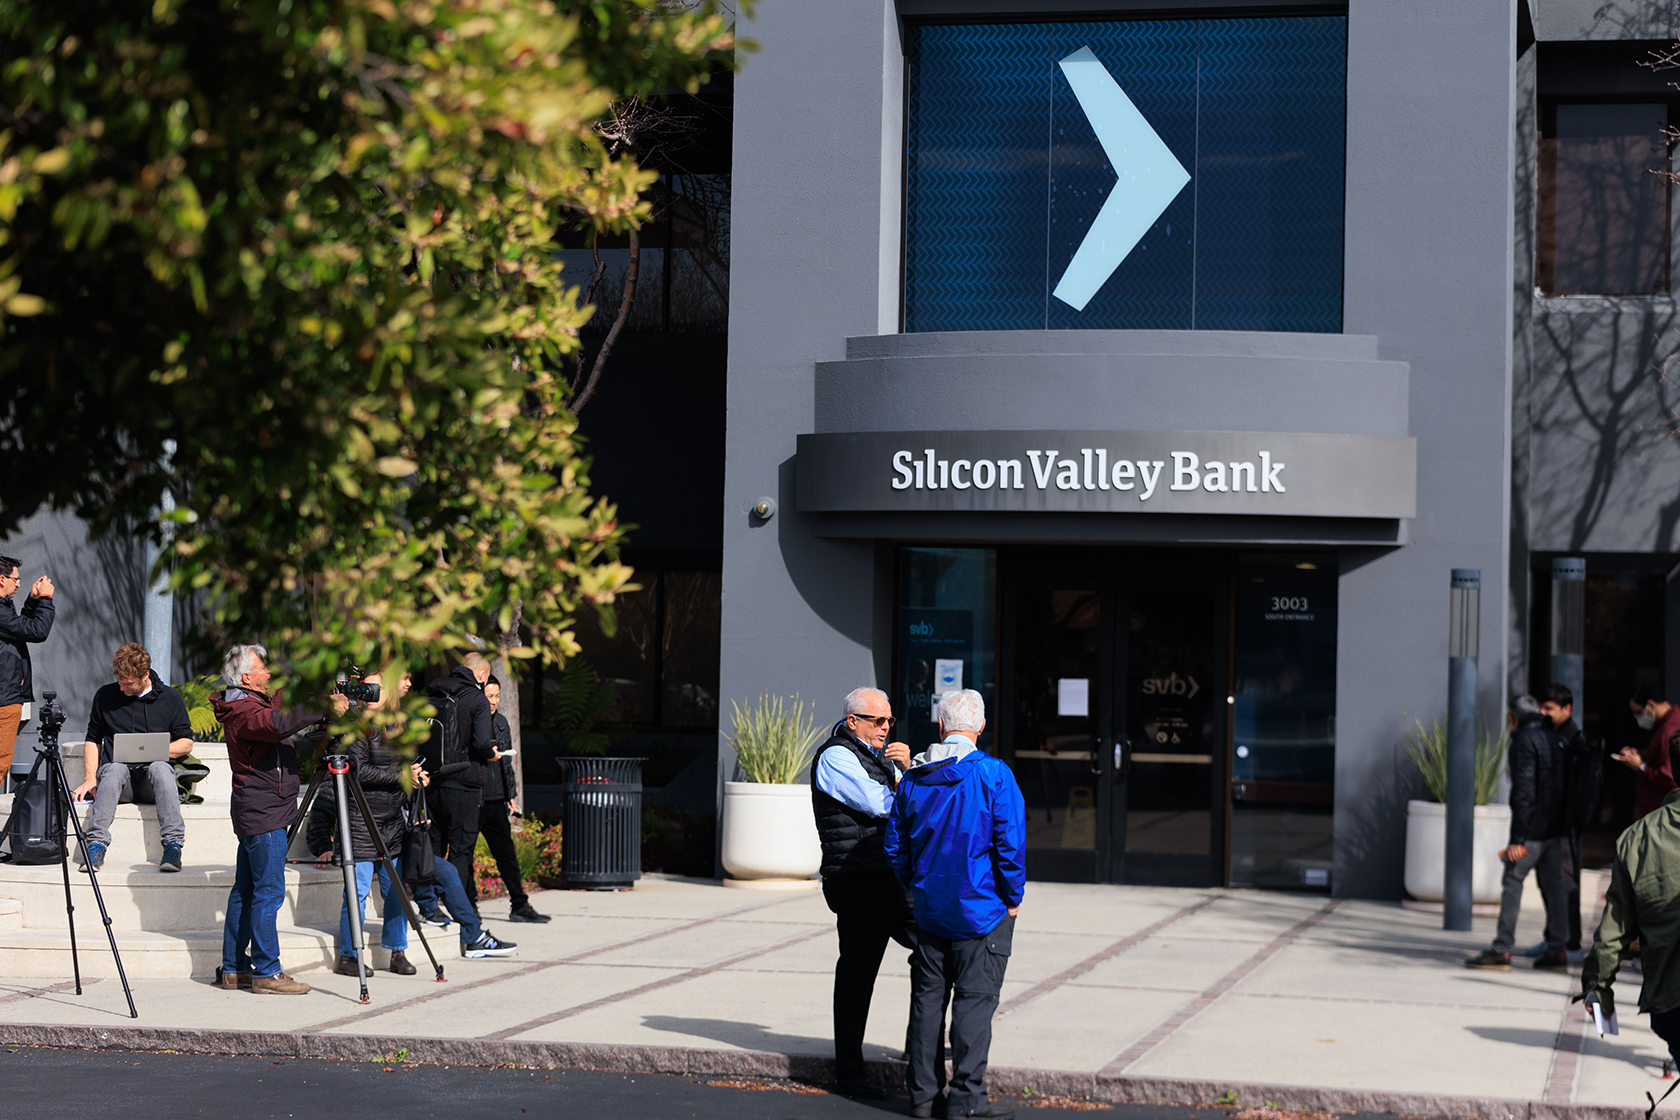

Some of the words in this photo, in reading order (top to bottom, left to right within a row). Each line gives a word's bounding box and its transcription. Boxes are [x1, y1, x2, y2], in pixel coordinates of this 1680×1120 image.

[892, 449, 1024, 491] Silicon
[1026, 449, 1164, 500] Valley
[1170, 451, 1286, 493] Bank
[1271, 596, 1309, 611] 3003
[1285, 613, 1315, 621] ENTRANCE
[910, 621, 929, 635] svb
[1142, 673, 1187, 695] svb
